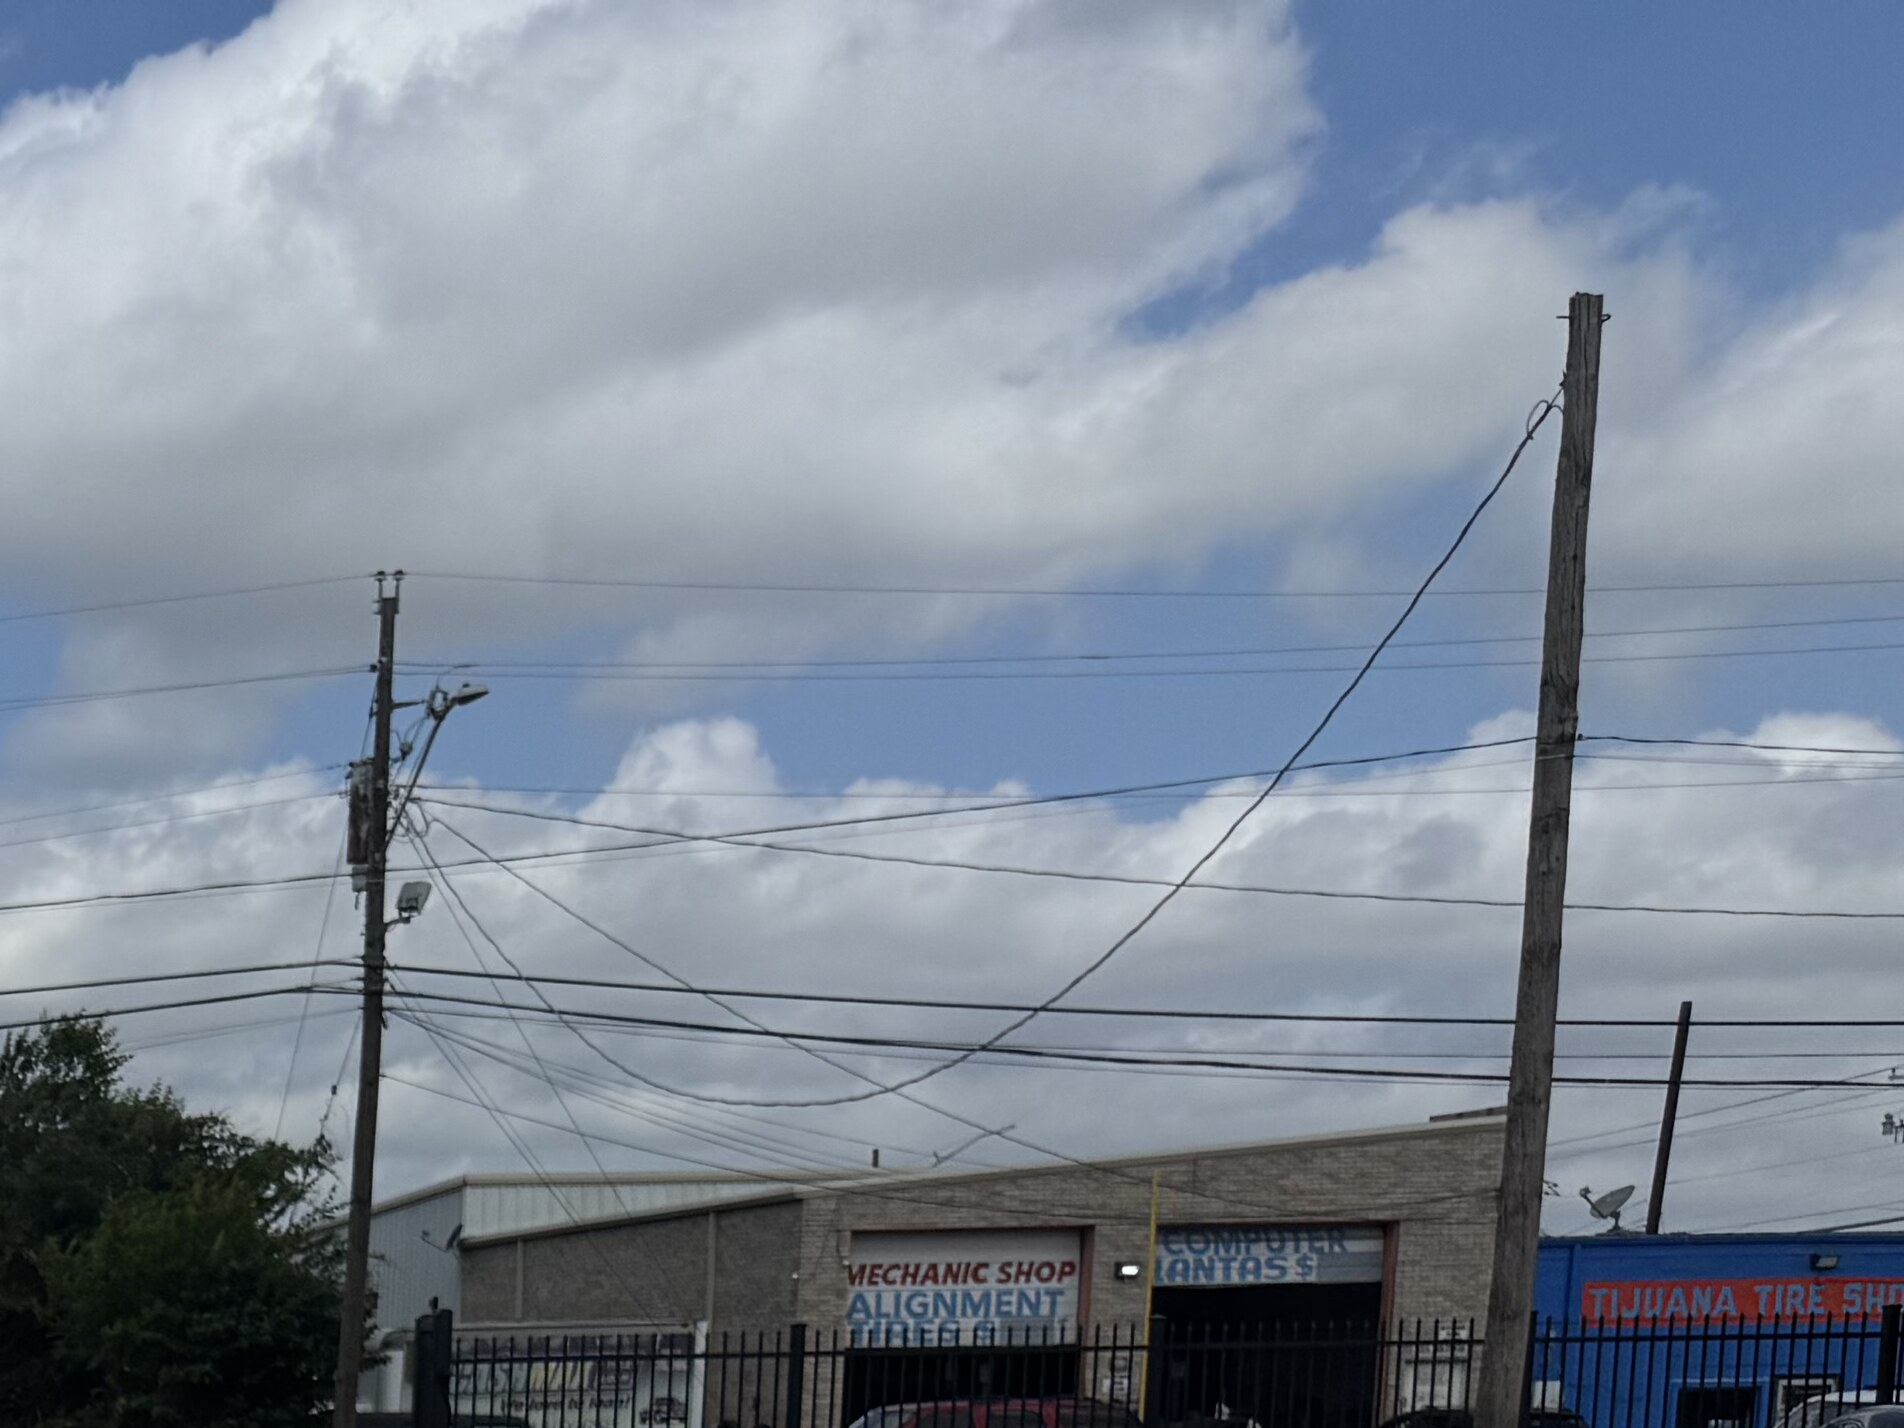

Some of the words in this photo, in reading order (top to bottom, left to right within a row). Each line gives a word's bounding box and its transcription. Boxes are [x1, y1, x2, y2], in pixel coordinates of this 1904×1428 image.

[1163, 1230, 1347, 1255] COMPUTER
[847, 1262, 989, 1286] MECHANIC
[996, 1261, 1076, 1285] SHOP
[848, 1289, 1064, 1319] ALIGNMENT
[1589, 1286, 1737, 1318] TIJUANA
[1753, 1284, 1827, 1316] TIRE
[848, 1320, 959, 1344] TIRES
